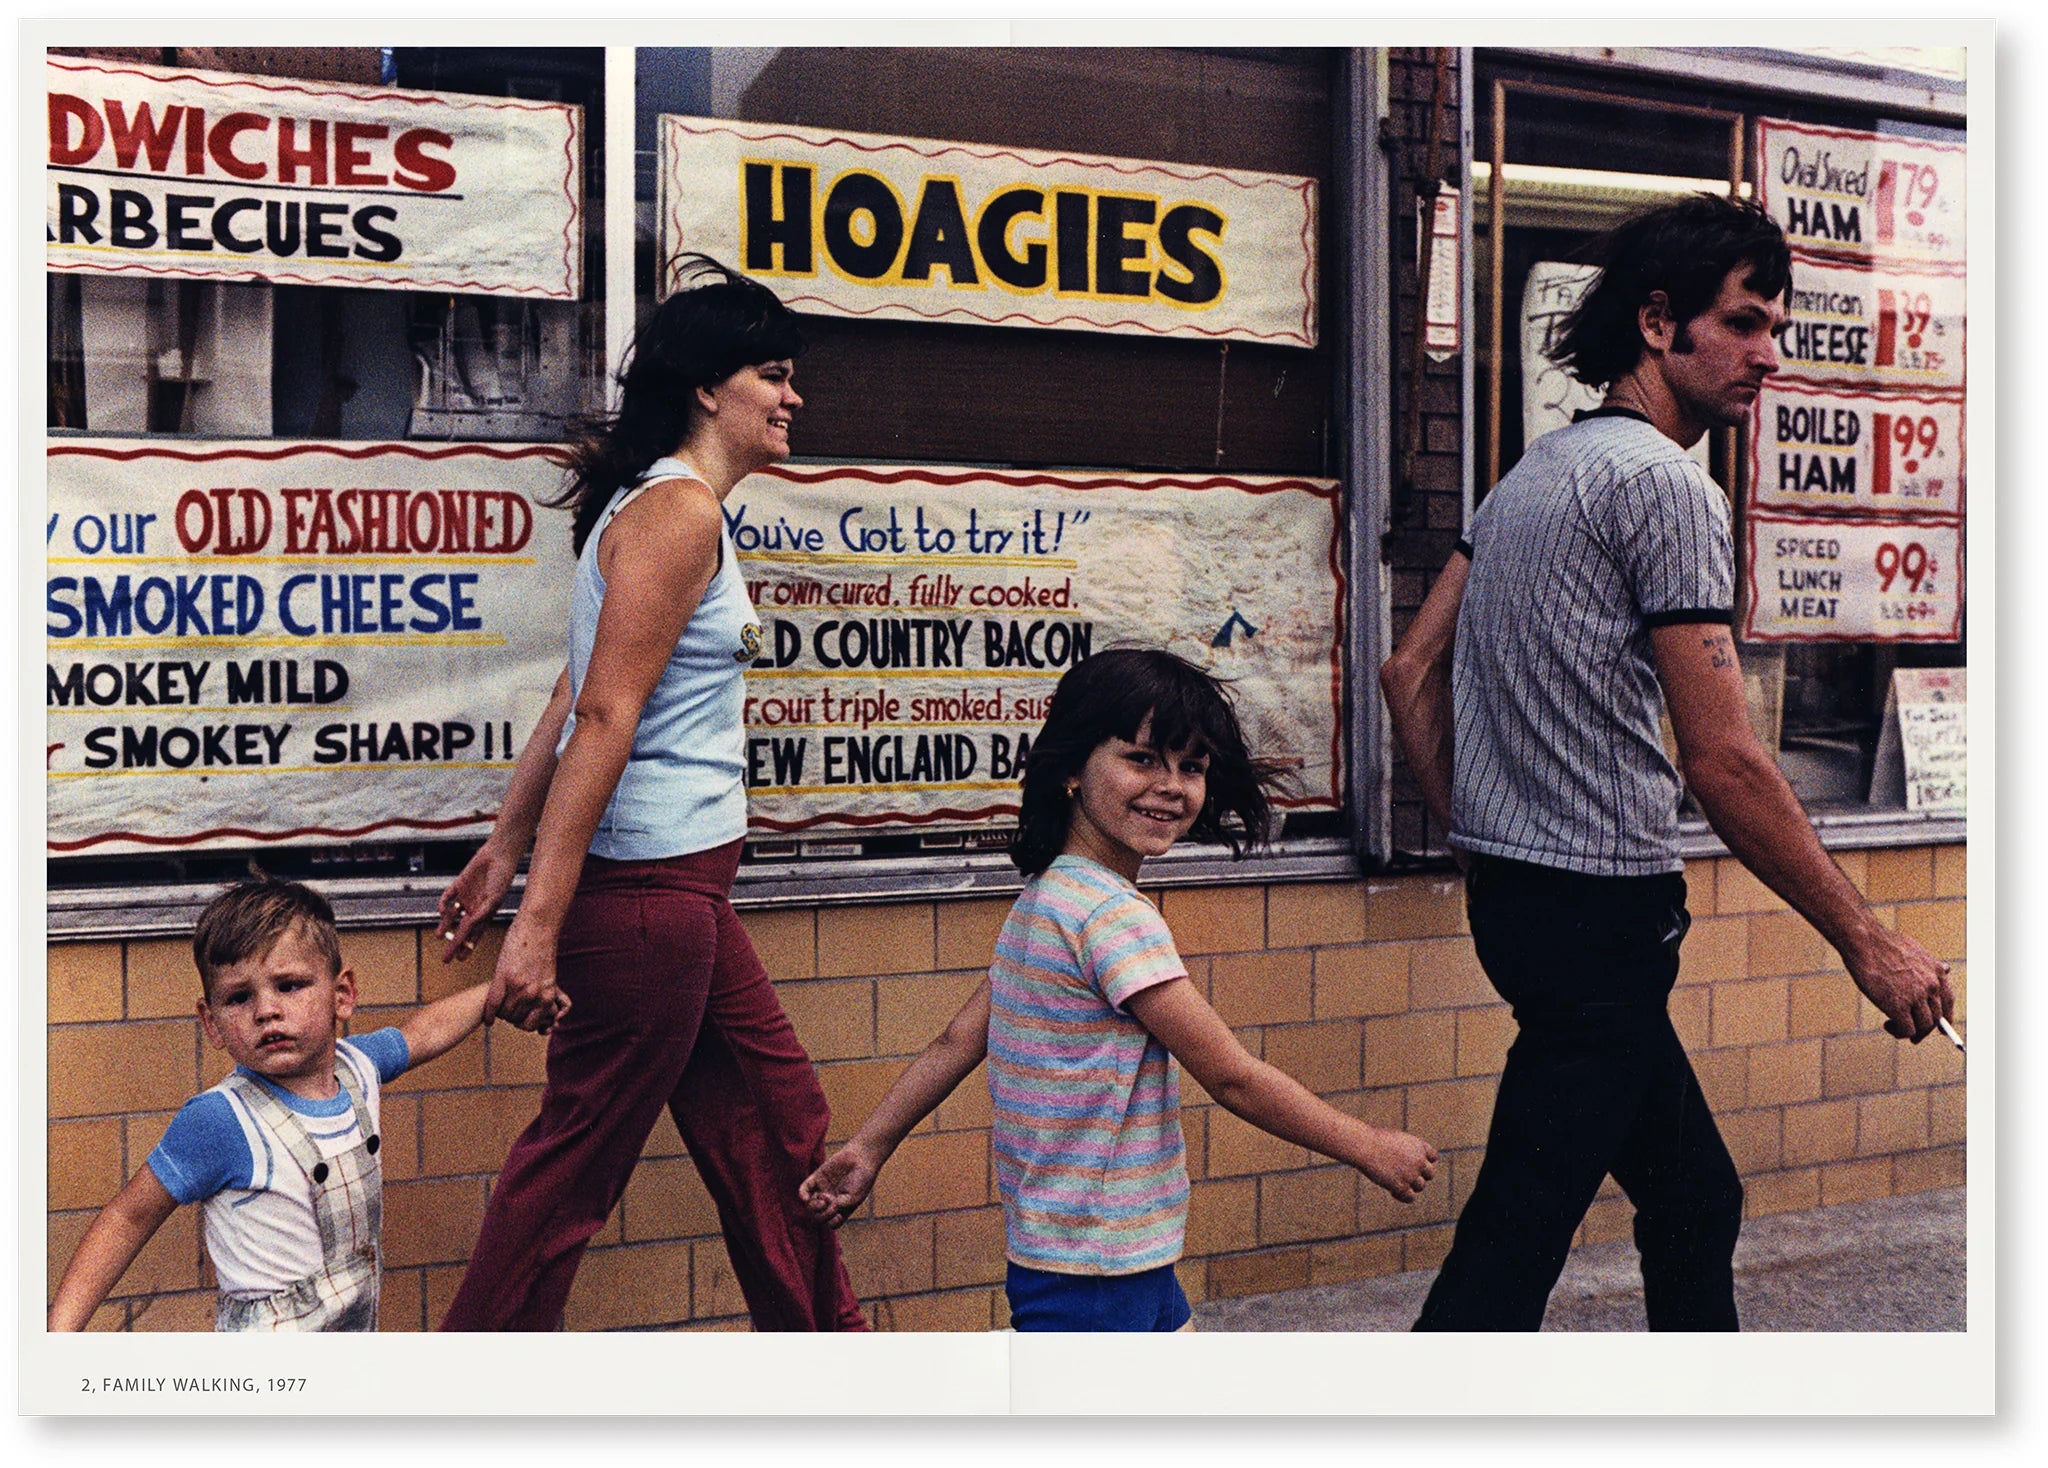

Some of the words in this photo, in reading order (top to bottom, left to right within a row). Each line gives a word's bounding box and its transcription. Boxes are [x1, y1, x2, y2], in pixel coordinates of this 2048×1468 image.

[47, 92, 457, 191] DWICHES
[47, 183, 402, 262] RBECUES
[741, 157, 1228, 311] HOAGIES
[1788, 197, 1862, 242] HAM
[1791, 289, 1863, 316] merican
[1779, 321, 1869, 364] CHEESE
[1777, 405, 1860, 446] BOILED
[1780, 452, 1856, 494] HAM
[73, 513, 156, 554] our
[175, 488, 272, 556] OLD
[280, 489, 532, 555] FASHIONED
[721, 504, 824, 551] You've
[839, 506, 906, 553] Got
[915, 507, 955, 552] to
[966, 508, 1011, 553] try
[1776, 539, 1840, 558] SPICED
[774, 581, 822, 606] own
[909, 574, 964, 607] fully
[1779, 570, 1841, 591] LUNCH
[47, 574, 264, 637] SMOKED
[279, 573, 482, 636] CHEESE
[1780, 597, 1838, 618] MEAT
[814, 619, 973, 669] COUNTRY
[985, 620, 1092, 669] BACON
[47, 661, 210, 706] MOKEY
[227, 660, 350, 703] MILD
[762, 697, 815, 725] our
[822, 687, 900, 731] triple
[85, 725, 292, 768] SMOKEY
[313, 721, 513, 764] SHARP!!
[742, 736, 806, 787] EW
[824, 734, 977, 785] ENGLAND
